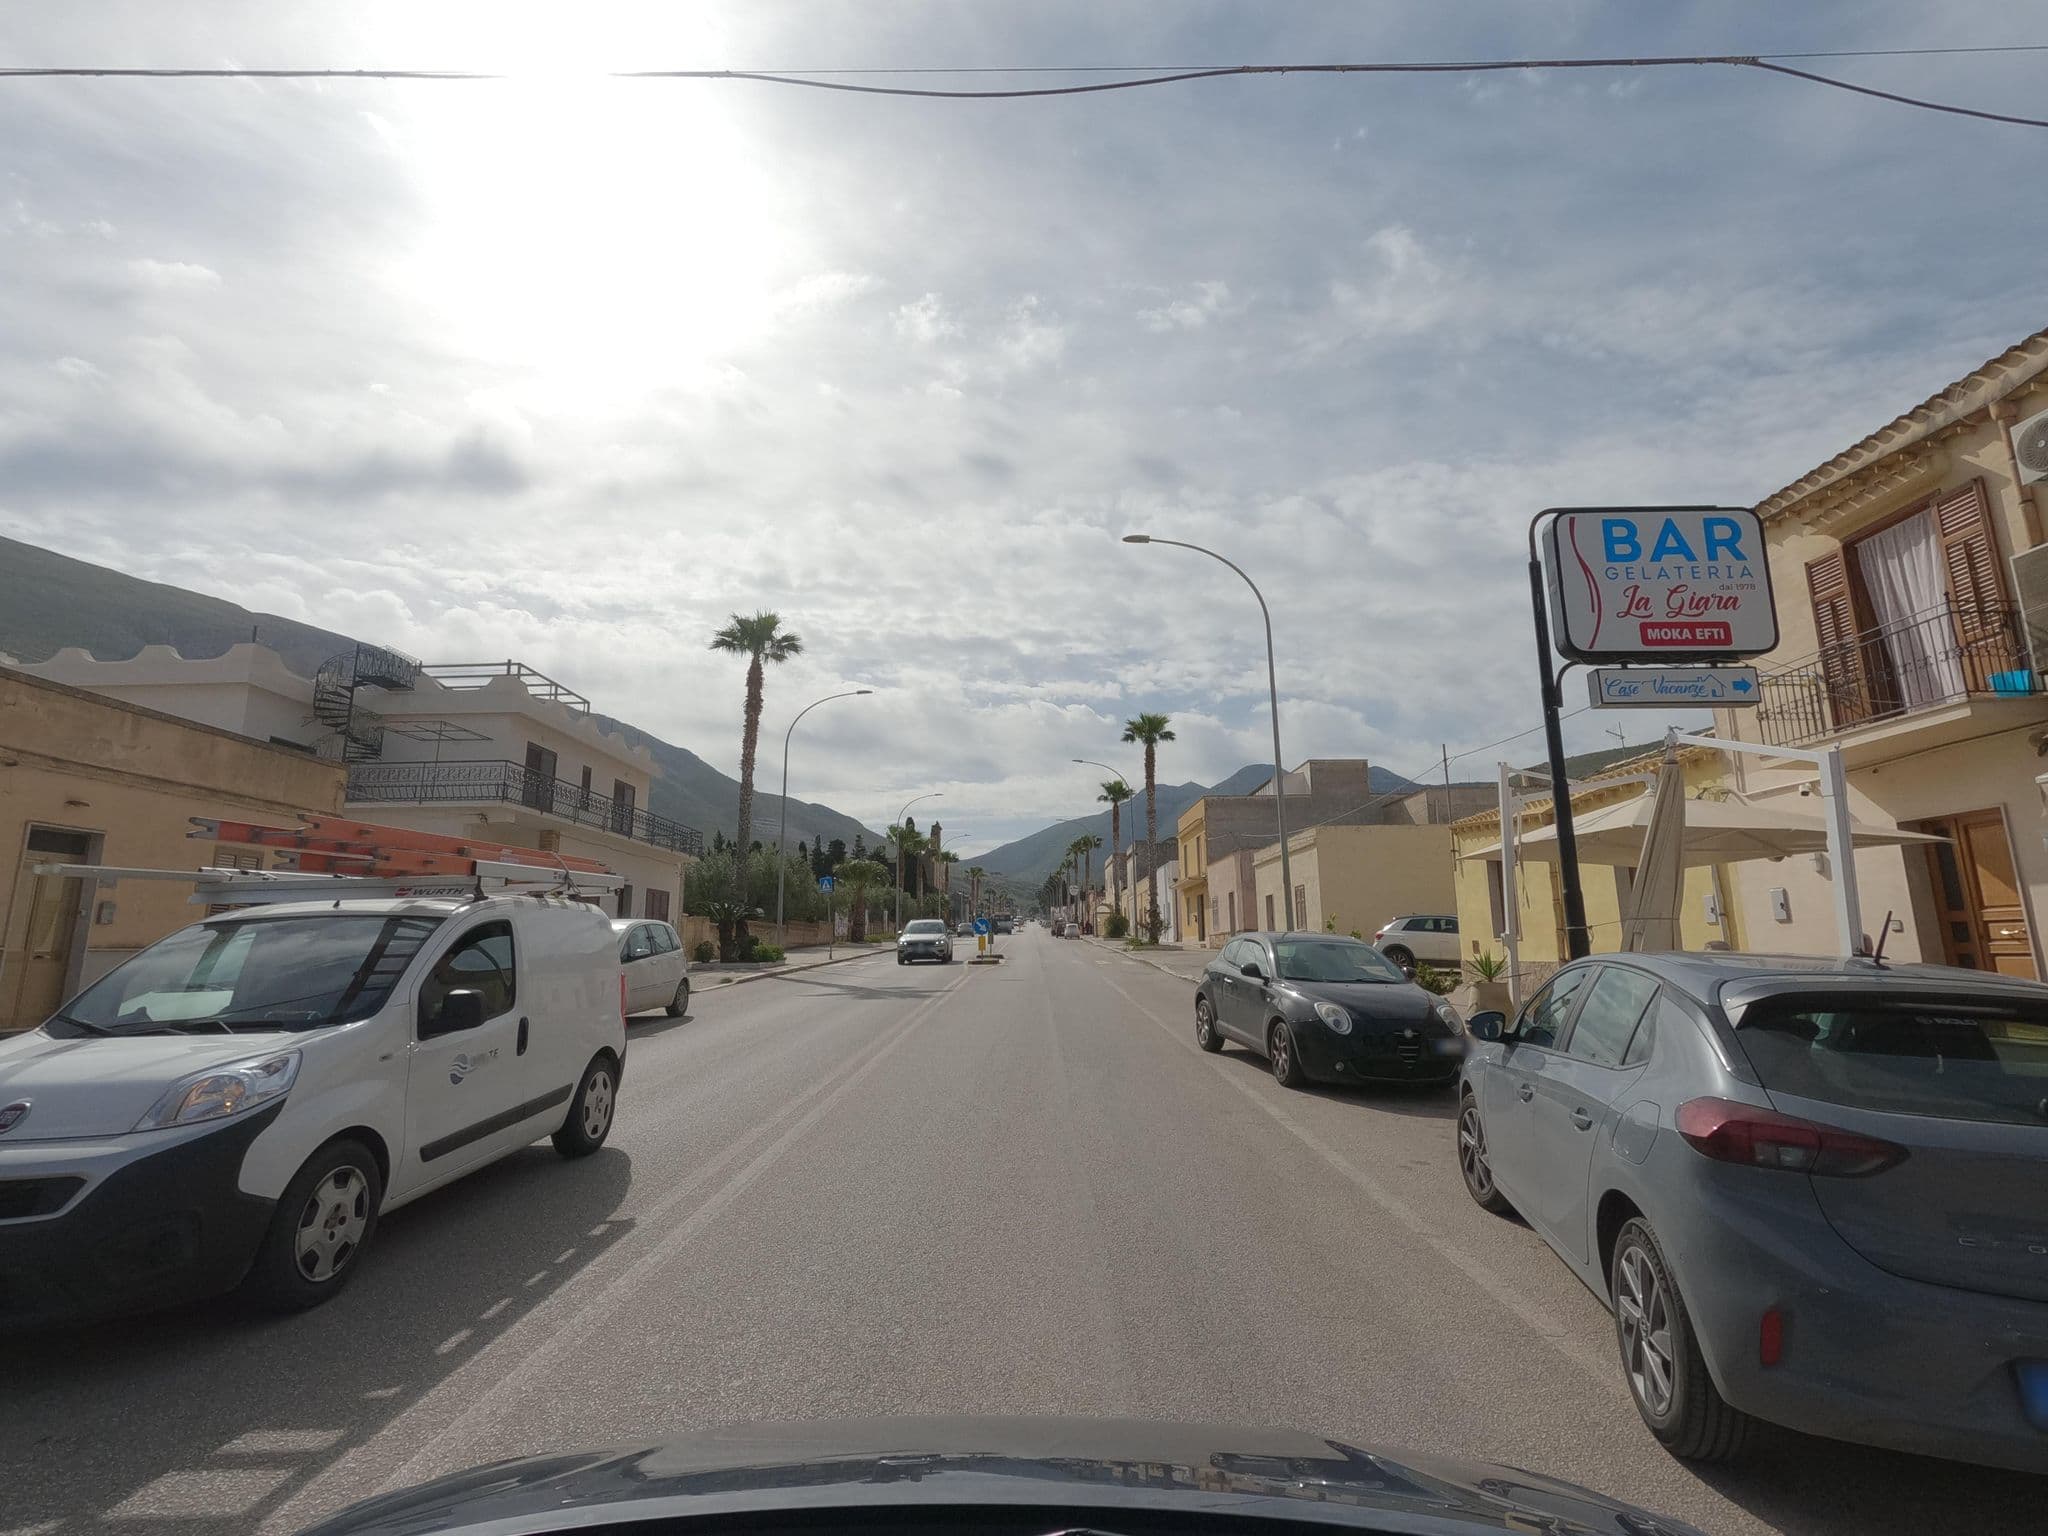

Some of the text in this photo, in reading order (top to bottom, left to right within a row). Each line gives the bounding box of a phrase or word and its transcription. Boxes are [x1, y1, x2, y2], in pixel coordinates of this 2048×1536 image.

[1601, 517, 1748, 563] BAR
[1604, 565, 1754, 581] GELATERIA
[1616, 584, 1742, 619] La Giara
[1646, 627, 1725, 641] MOKA EFTI
[1604, 675, 1709, 698] Case Vacanze
